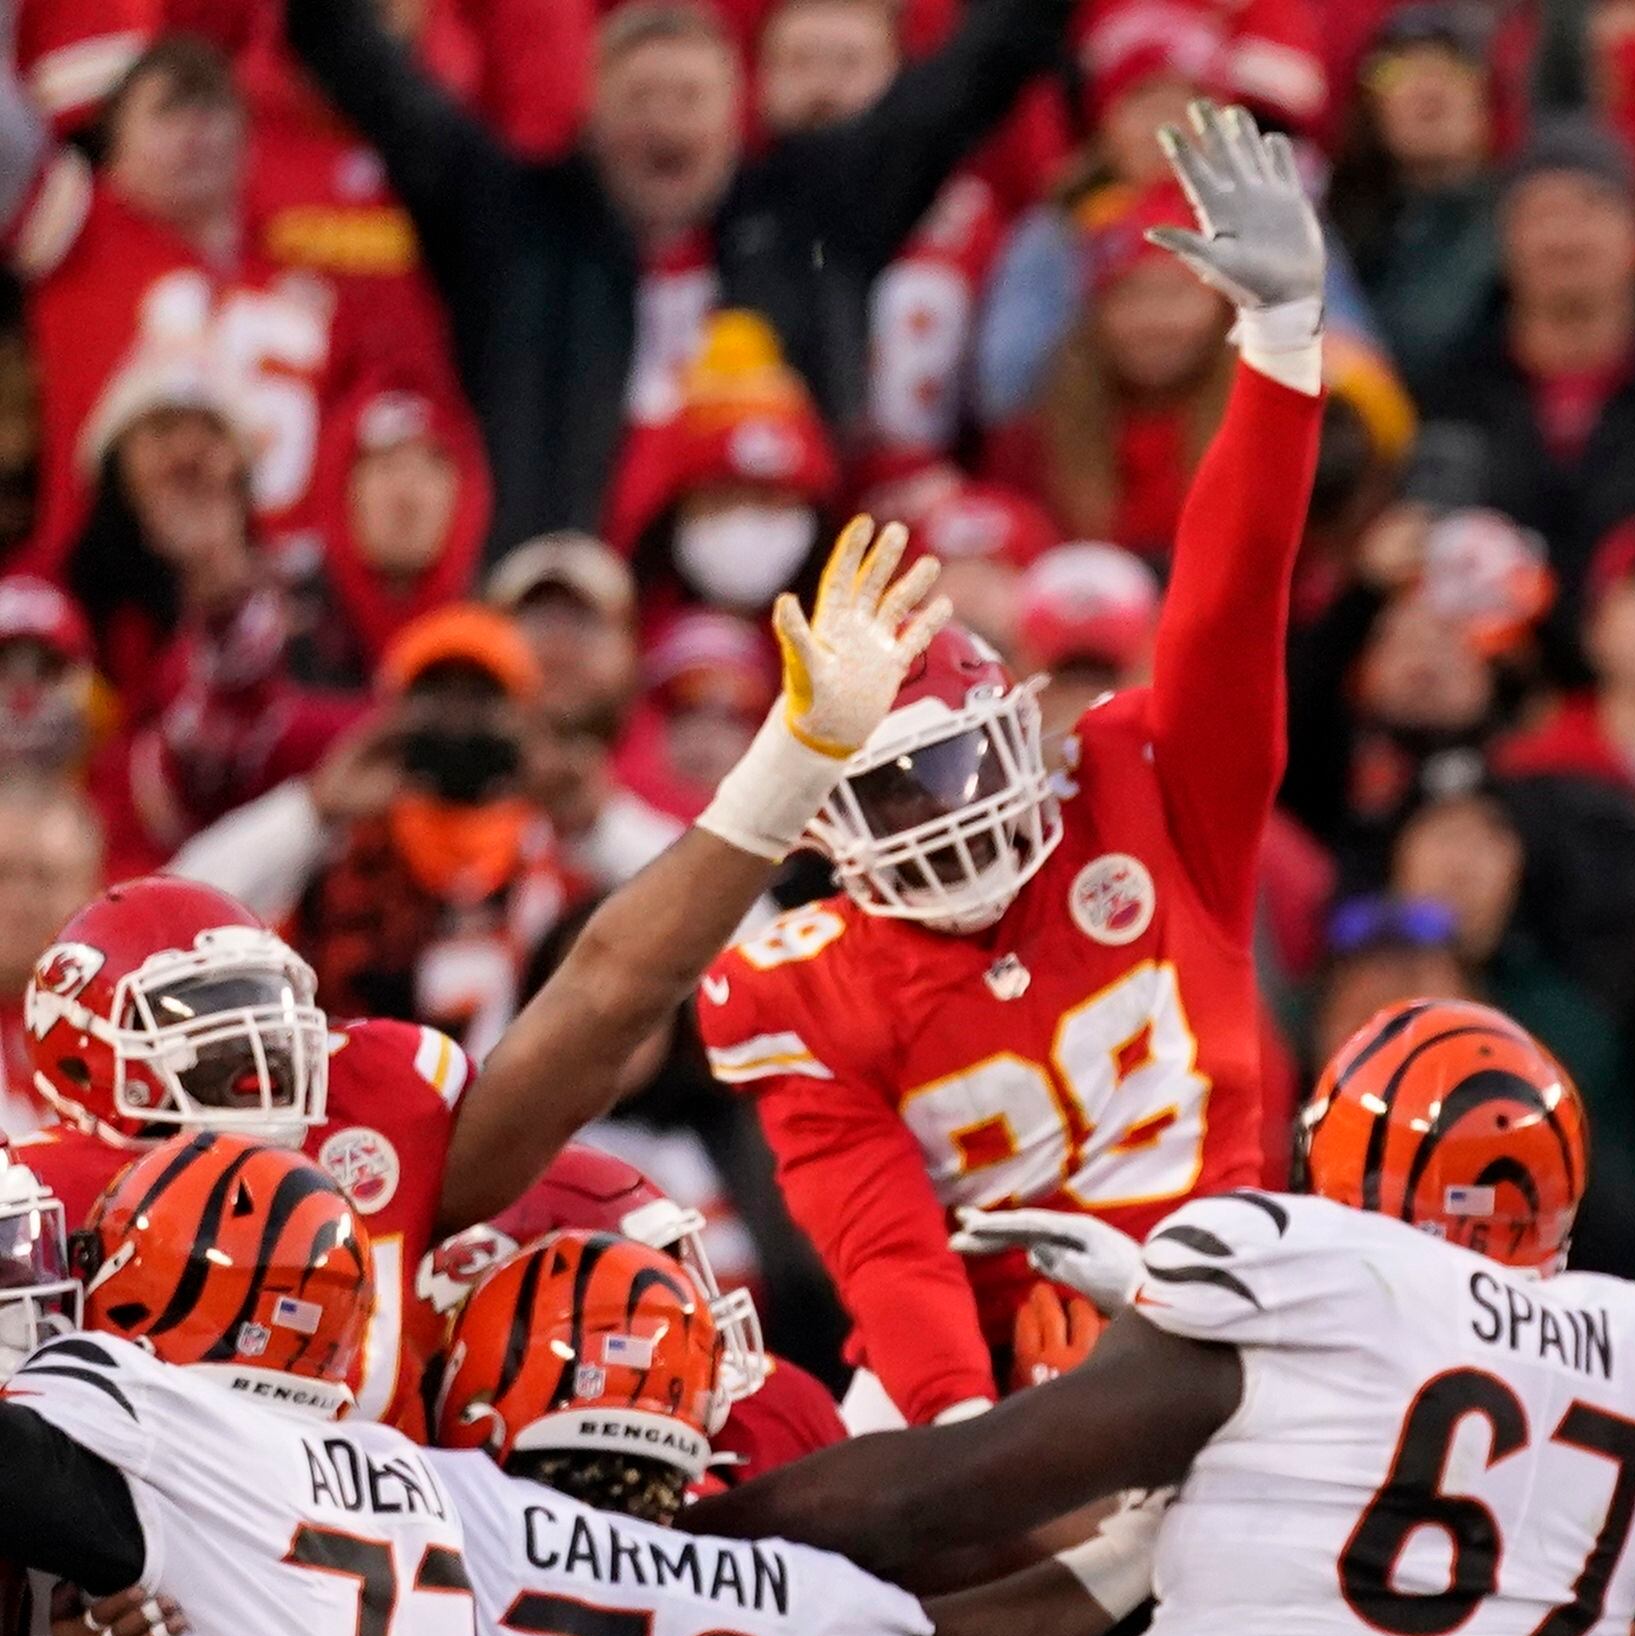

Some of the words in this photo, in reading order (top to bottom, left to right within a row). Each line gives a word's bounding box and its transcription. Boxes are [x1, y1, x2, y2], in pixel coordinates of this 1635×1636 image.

[903, 961, 1212, 1212] 98
[1467, 1270, 1613, 1381] SPAIN
[524, 1504, 787, 1616] CARMAN
